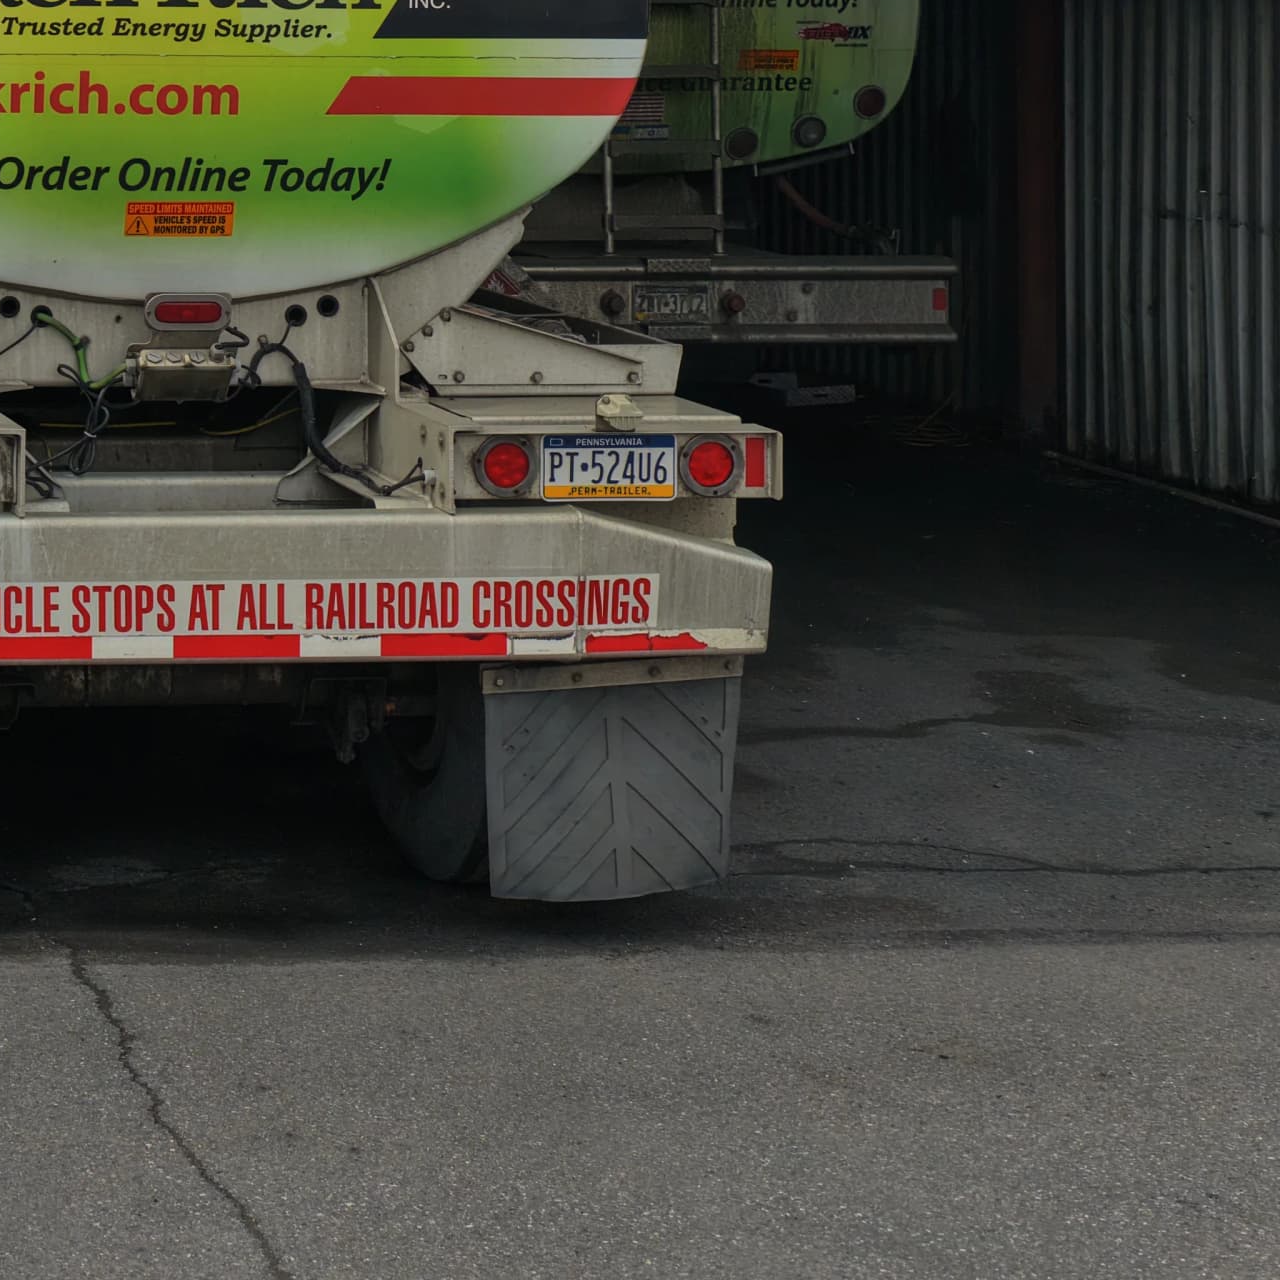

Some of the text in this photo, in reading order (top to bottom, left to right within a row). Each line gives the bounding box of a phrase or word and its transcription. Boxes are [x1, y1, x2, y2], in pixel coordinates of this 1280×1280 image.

[2, 17, 103, 37] Trusted
[112, 17, 206, 42] Energy
[214, 18, 333, 43] Supplier.
[118, 157, 251, 192] Online
[262, 158, 392, 201] Today!
[129, 203, 232, 213] SPEED LIMITS MAINTAINED
[154, 216, 226, 224] VEHICLE'S SPEED IS
[154, 226, 197, 234] MONITORED
[210, 226, 225, 234] GPS
[576, 438, 642, 446] PENNSYLVANIA
[72, 584, 175, 632] STOPS
[188, 584, 225, 631] AT
[237, 584, 293, 631] ALL
[305, 582, 459, 629] RAILROAD
[472, 578, 651, 628] CROSSINGS
